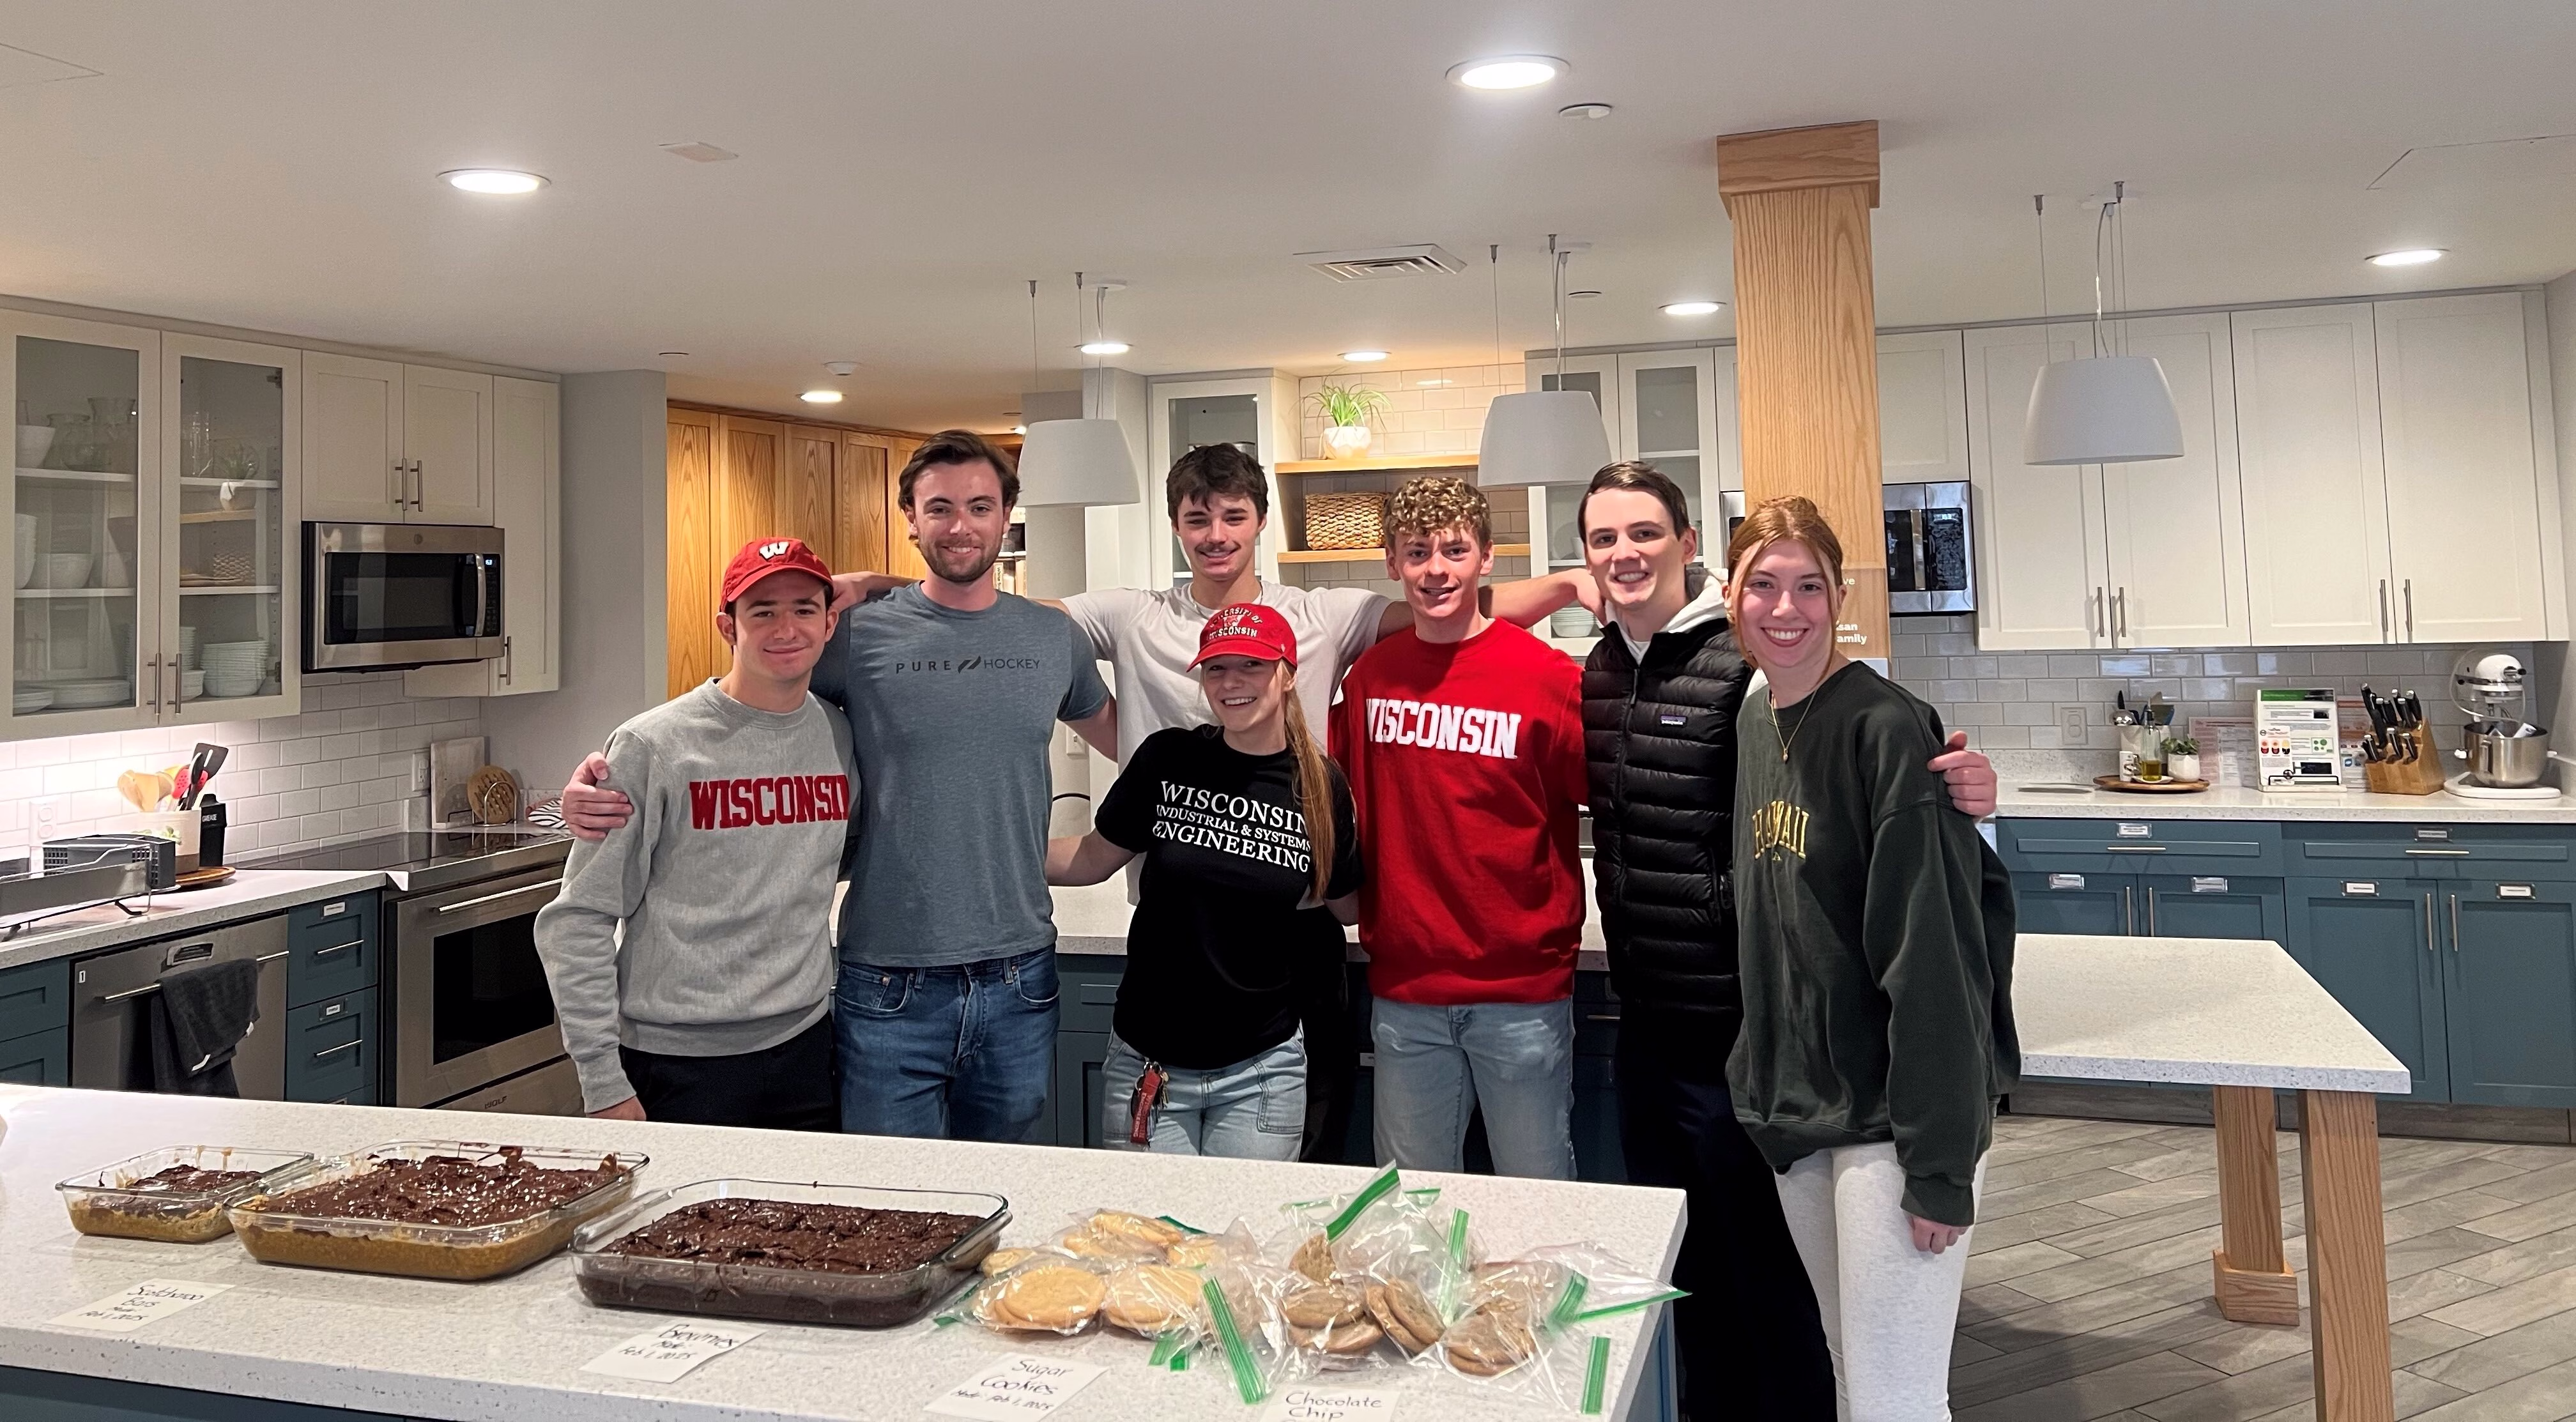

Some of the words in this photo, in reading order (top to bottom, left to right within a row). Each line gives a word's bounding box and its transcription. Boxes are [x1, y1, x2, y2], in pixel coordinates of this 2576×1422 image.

[758, 541, 790, 561] W
[1209, 607, 1252, 628] ERSITY
[1836, 623, 1858, 631] san
[1837, 633, 1867, 645] amily
[896, 660, 951, 674] PURE
[984, 659, 1040, 669] HOCKEY
[1161, 781, 1308, 837] WISCONSIN
[1156, 804, 1238, 834] INDUSTRIAL
[1241, 824, 1252, 836] &
[1254, 827, 1311, 852] SYSTEMS
[1153, 820, 1310, 873] ENGINEERING
[484, 1095, 507, 1110] WOLF
[1012, 1359, 1074, 1379] Sugar
[981, 1375, 1059, 1395] Cookies
[1285, 1390, 1383, 1407] Chocolate
[1289, 1407, 1344, 1421] Chip
